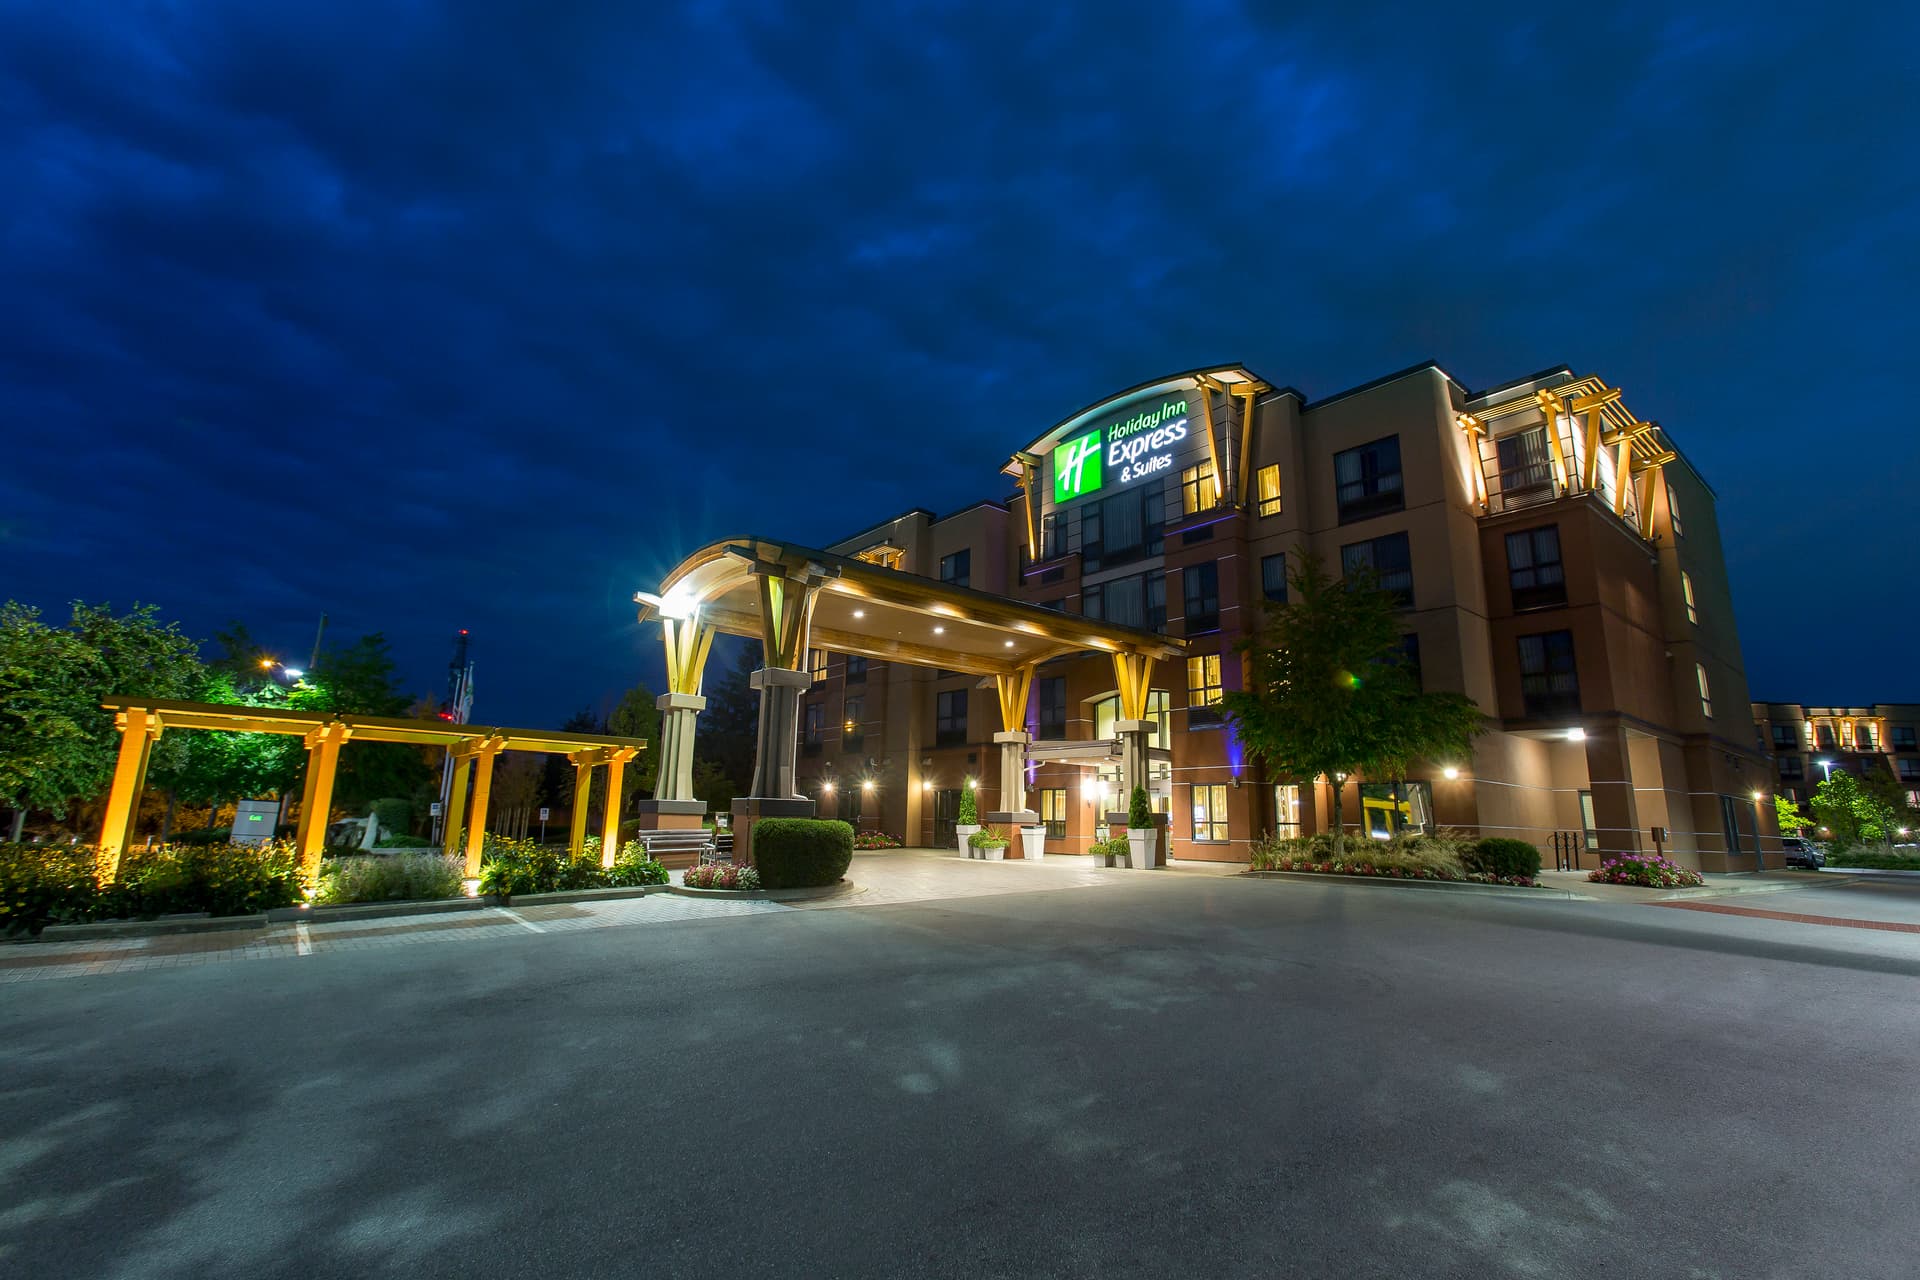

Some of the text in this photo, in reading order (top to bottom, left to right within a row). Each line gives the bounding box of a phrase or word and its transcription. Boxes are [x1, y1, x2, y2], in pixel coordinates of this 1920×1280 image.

[1108, 400, 1187, 442] Holiday Inn
[1108, 419, 1187, 466] Express
[1121, 454, 1172, 483] & Suites
